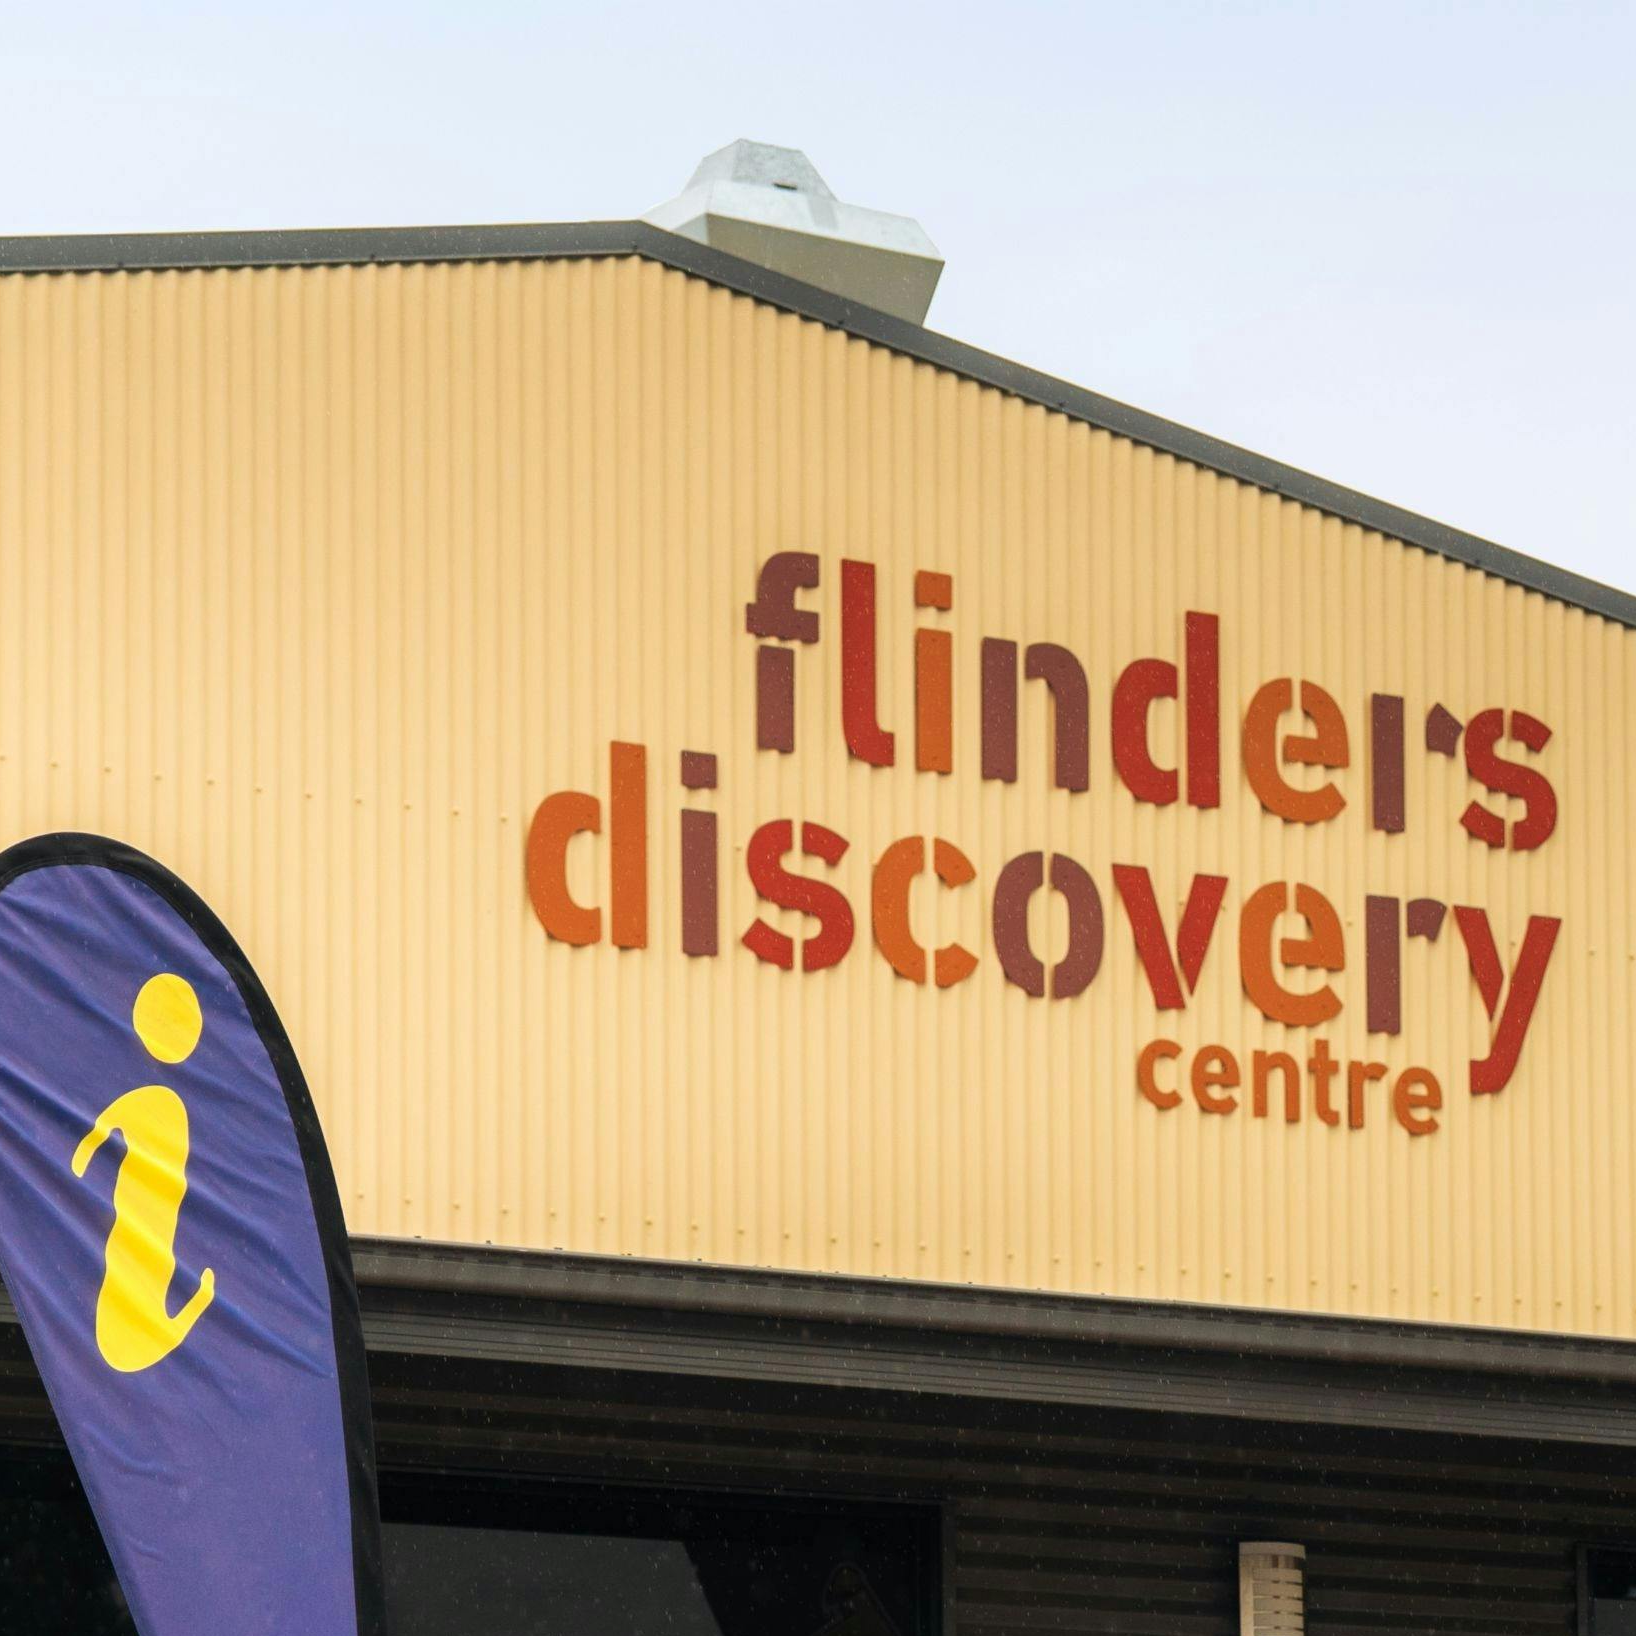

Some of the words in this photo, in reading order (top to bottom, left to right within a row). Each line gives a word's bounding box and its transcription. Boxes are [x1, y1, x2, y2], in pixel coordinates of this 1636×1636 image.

[746, 551, 1558, 851] flinders
[525, 741, 1562, 1096] discovery
[1137, 1038, 1443, 1136] centre
